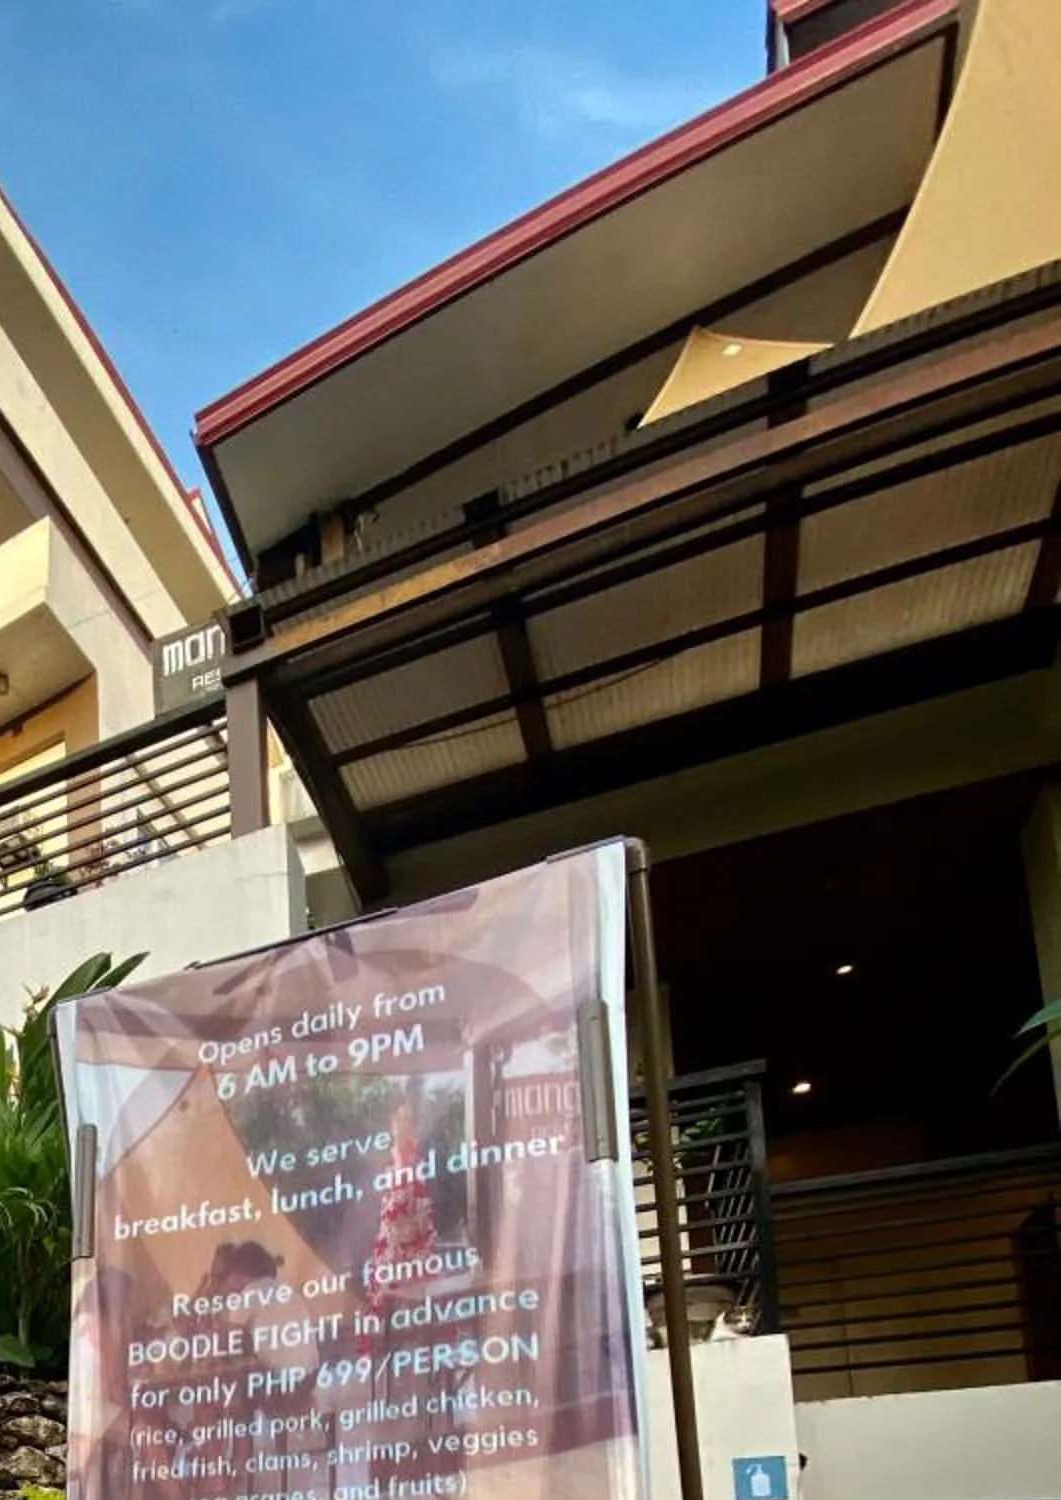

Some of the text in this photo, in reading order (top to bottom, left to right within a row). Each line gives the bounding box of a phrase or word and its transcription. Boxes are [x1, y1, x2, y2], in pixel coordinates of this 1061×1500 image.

[198, 982, 446, 1066] Opens daily from
[217, 1022, 425, 1100] 6 AM to 9PM
[113, 1132, 566, 1242] breakfast, lunch, and dinner
[245, 1129, 392, 1180] We serve
[173, 1247, 479, 1317] Reserve our famous
[127, 1287, 539, 1368] BOODLE FIGHT in advance
[131, 1332, 539, 1413] for only PHP 699/PERSON
[132, 1424, 539, 1483] fried fish, clams, shrimp, veggies
[193, 1414, 263, 1449] grilled
[269, 1409, 330, 1443] pork,
[339, 1398, 418, 1432] grilled
[426, 1385, 540, 1415] chicken,
[387, 1472, 469, 1499] fruits)
